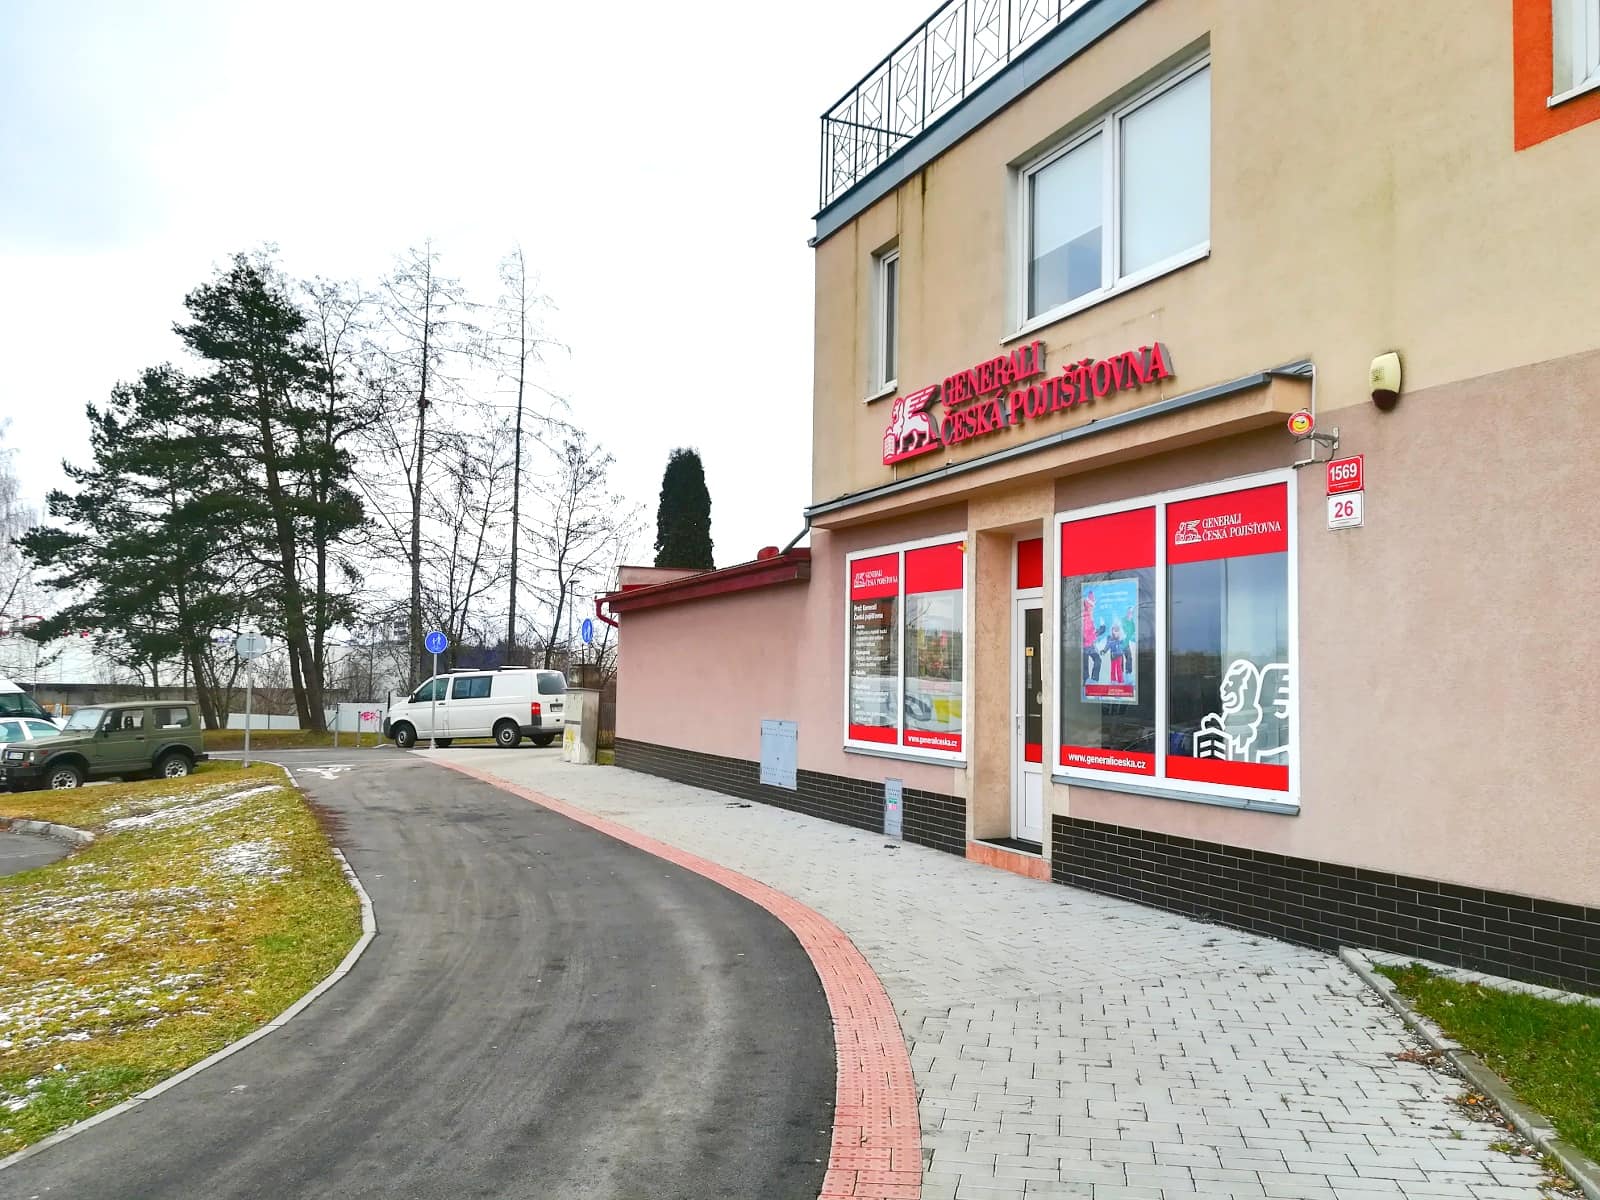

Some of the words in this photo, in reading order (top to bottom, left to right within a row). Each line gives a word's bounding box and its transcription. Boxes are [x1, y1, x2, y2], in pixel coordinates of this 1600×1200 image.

[941, 340, 1042, 407] GENERALI
[940, 391, 1003, 446] ČESKÁ
[1009, 341, 1170, 425] POJIŠŤOVNA
[1329, 463, 1358, 481] 1569
[1334, 500, 1354, 518] 26
[1202, 513, 1242, 528] GENERALI
[1202, 526, 1228, 541] ČESKÁ
[1229, 521, 1281, 537] POJIŠŤOVNA
[1068, 752, 1147, 769] www.generaliceska.cz
